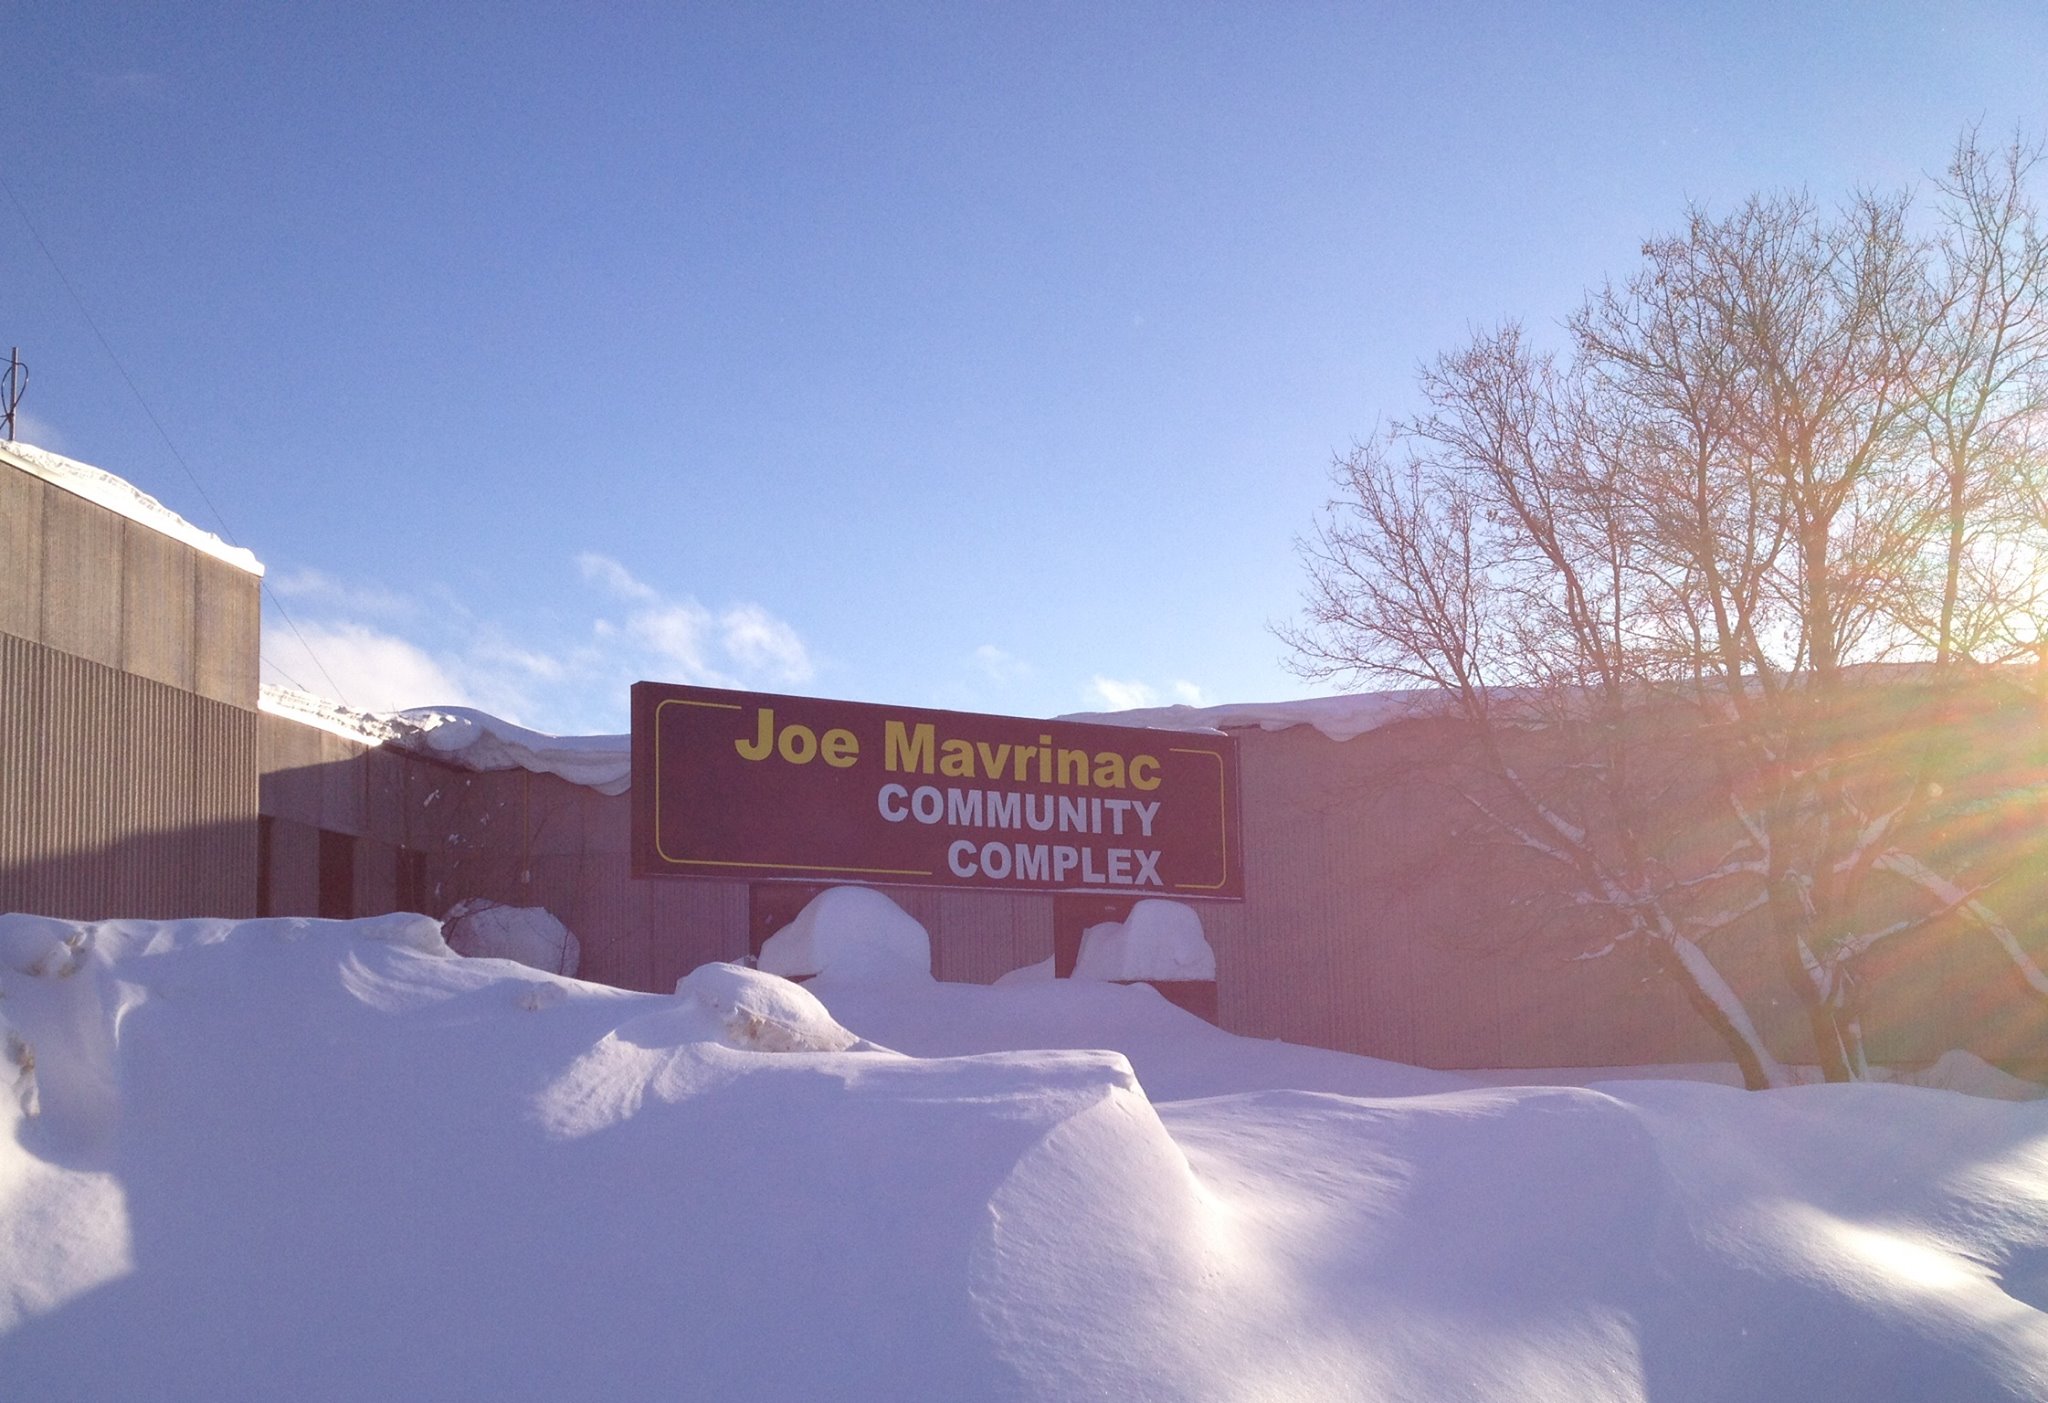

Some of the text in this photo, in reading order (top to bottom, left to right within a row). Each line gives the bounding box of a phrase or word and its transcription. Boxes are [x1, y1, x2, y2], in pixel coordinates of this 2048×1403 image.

[734, 708, 1163, 791] Joe Mavrinac
[877, 783, 1162, 837] COMMUNITY
[947, 839, 1164, 886] COMPLEX
